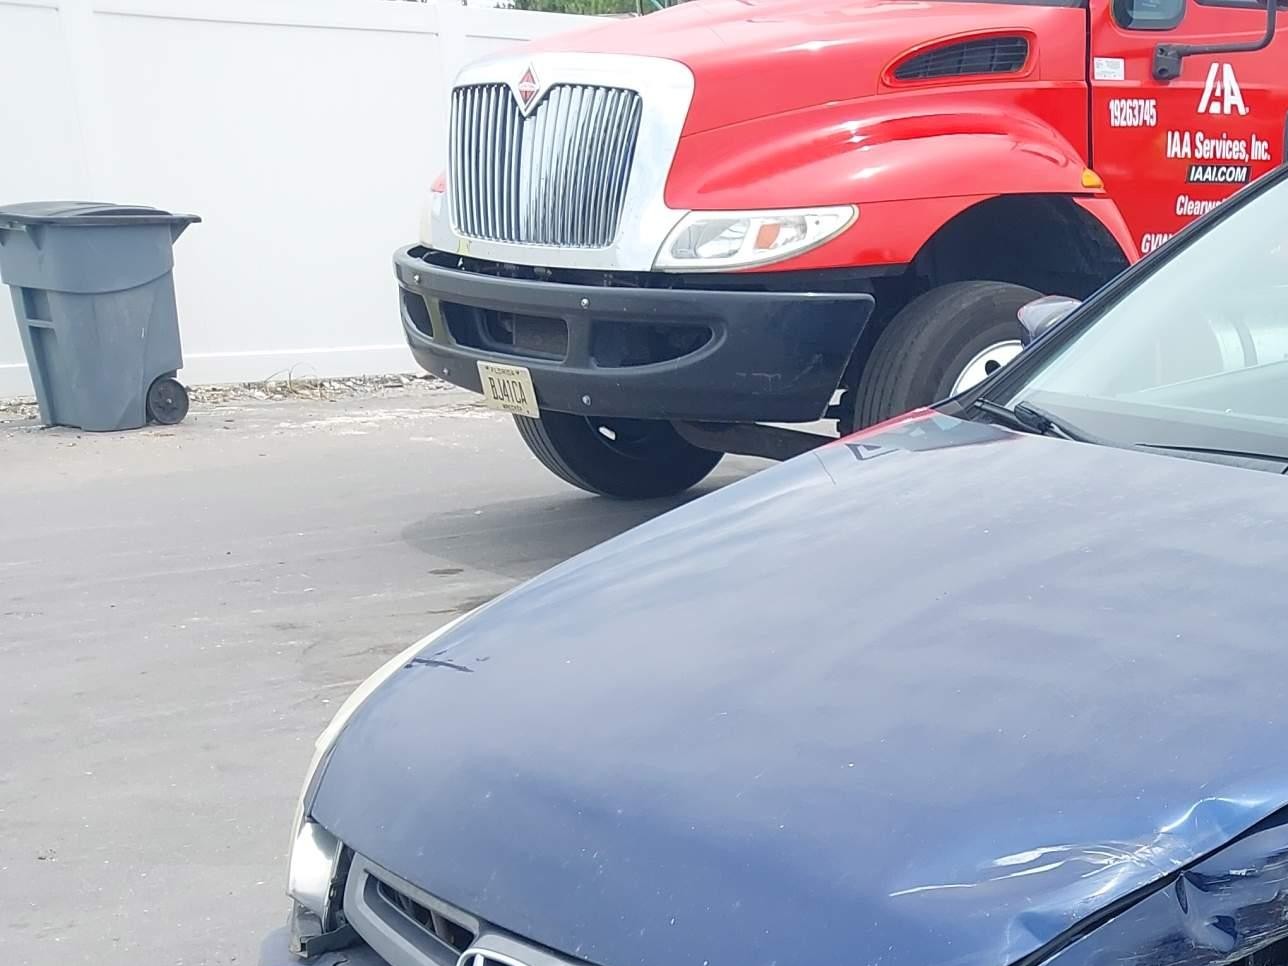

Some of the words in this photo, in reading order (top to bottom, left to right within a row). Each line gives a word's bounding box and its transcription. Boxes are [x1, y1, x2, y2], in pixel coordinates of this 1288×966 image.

[1109, 98, 1157, 127] 19263745
[1166, 130, 1191, 158] IAA
[1194, 131, 1249, 162] Services,
[1251, 133, 1271, 160] Inc.
[1189, 165, 1248, 182] IAAI.COM
[488, 376, 528, 405] BJ41CA
